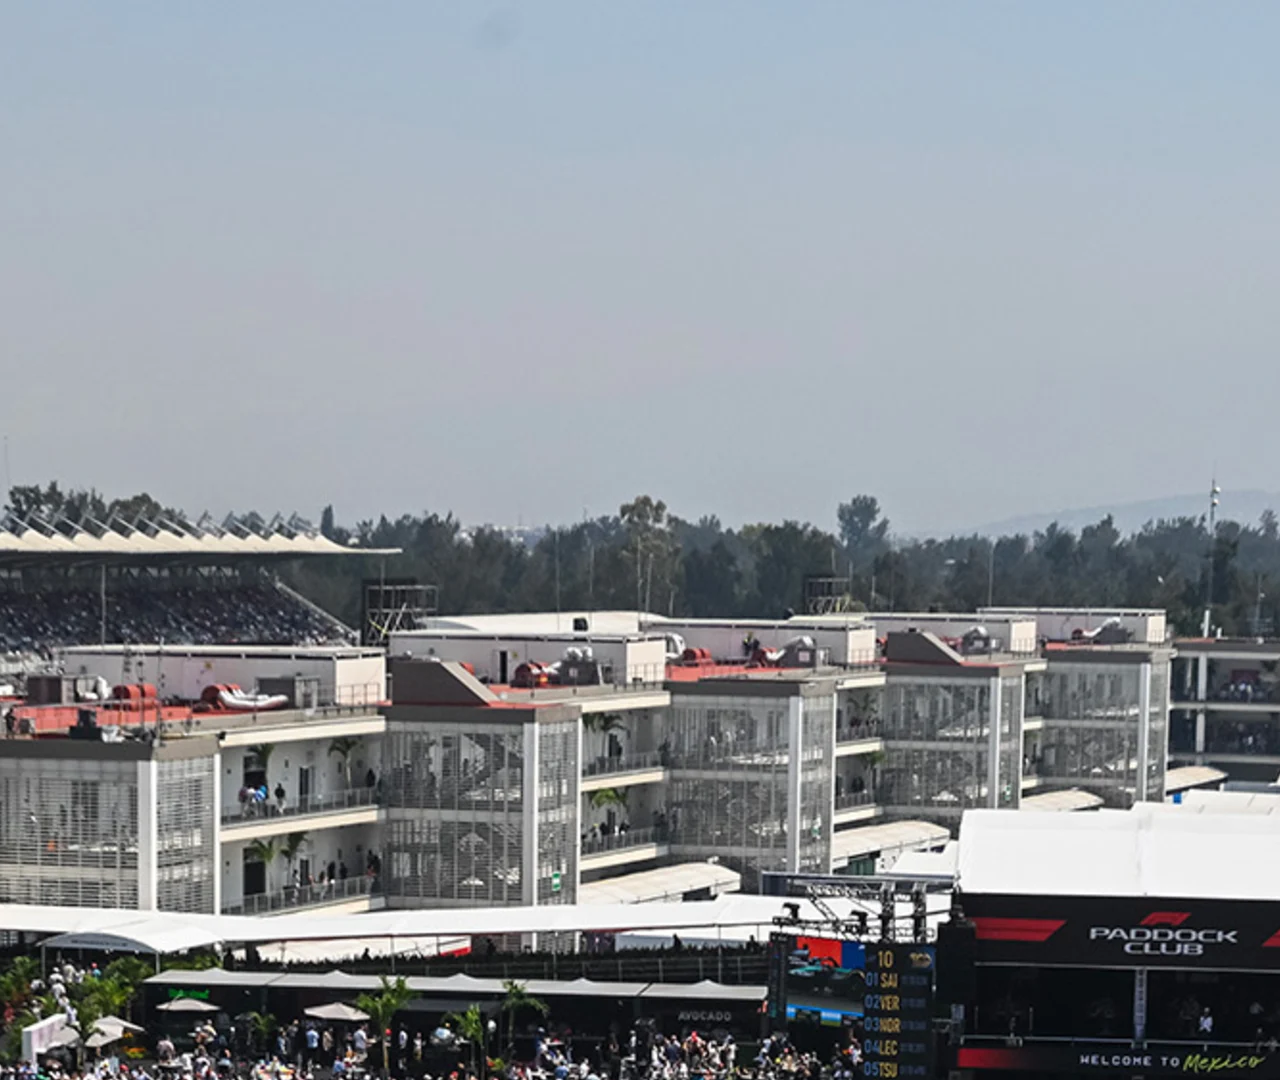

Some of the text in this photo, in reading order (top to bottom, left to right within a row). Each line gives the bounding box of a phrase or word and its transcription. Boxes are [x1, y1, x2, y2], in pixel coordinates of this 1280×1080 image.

[1089, 927, 1237, 943] PADDOCK
[1123, 942, 1204, 956] CLUB
[880, 995, 900, 1010] VER
[678, 1011, 732, 1021] AVOCADO
[879, 1040, 898, 1055] LEC
[878, 1062, 898, 1077] TSU
[1080, 1054, 1266, 1073] WELCOME TO Mexico
